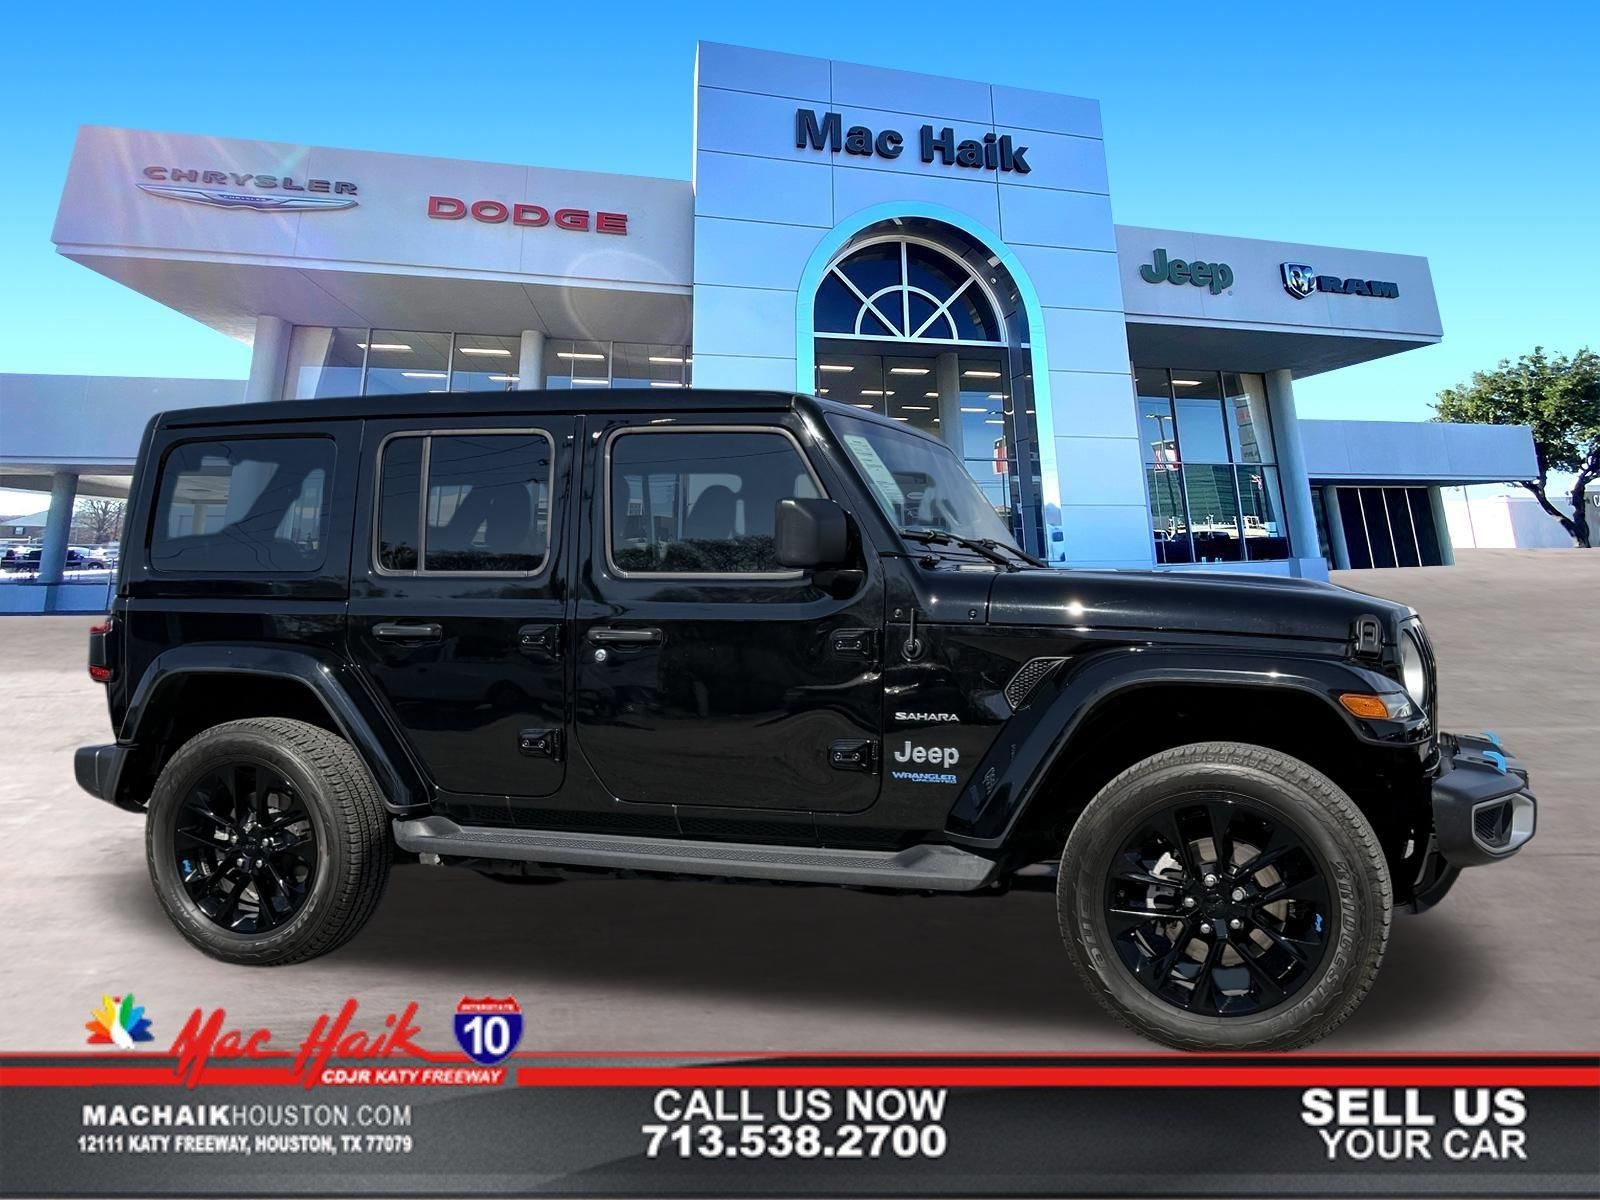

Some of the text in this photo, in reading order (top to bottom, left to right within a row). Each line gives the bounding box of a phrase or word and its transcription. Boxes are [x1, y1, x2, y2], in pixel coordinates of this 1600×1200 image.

[796, 108, 1032, 174] Mac Haik
[143, 166, 359, 196] CHRYSLER
[427, 195, 628, 236] DODGE
[1139, 248, 1234, 295] Jeep
[1315, 275, 1400, 299] RAM
[894, 711, 960, 722] SAHARA
[893, 740, 960, 769] Jeep
[892, 771, 957, 781] WRANGLER
